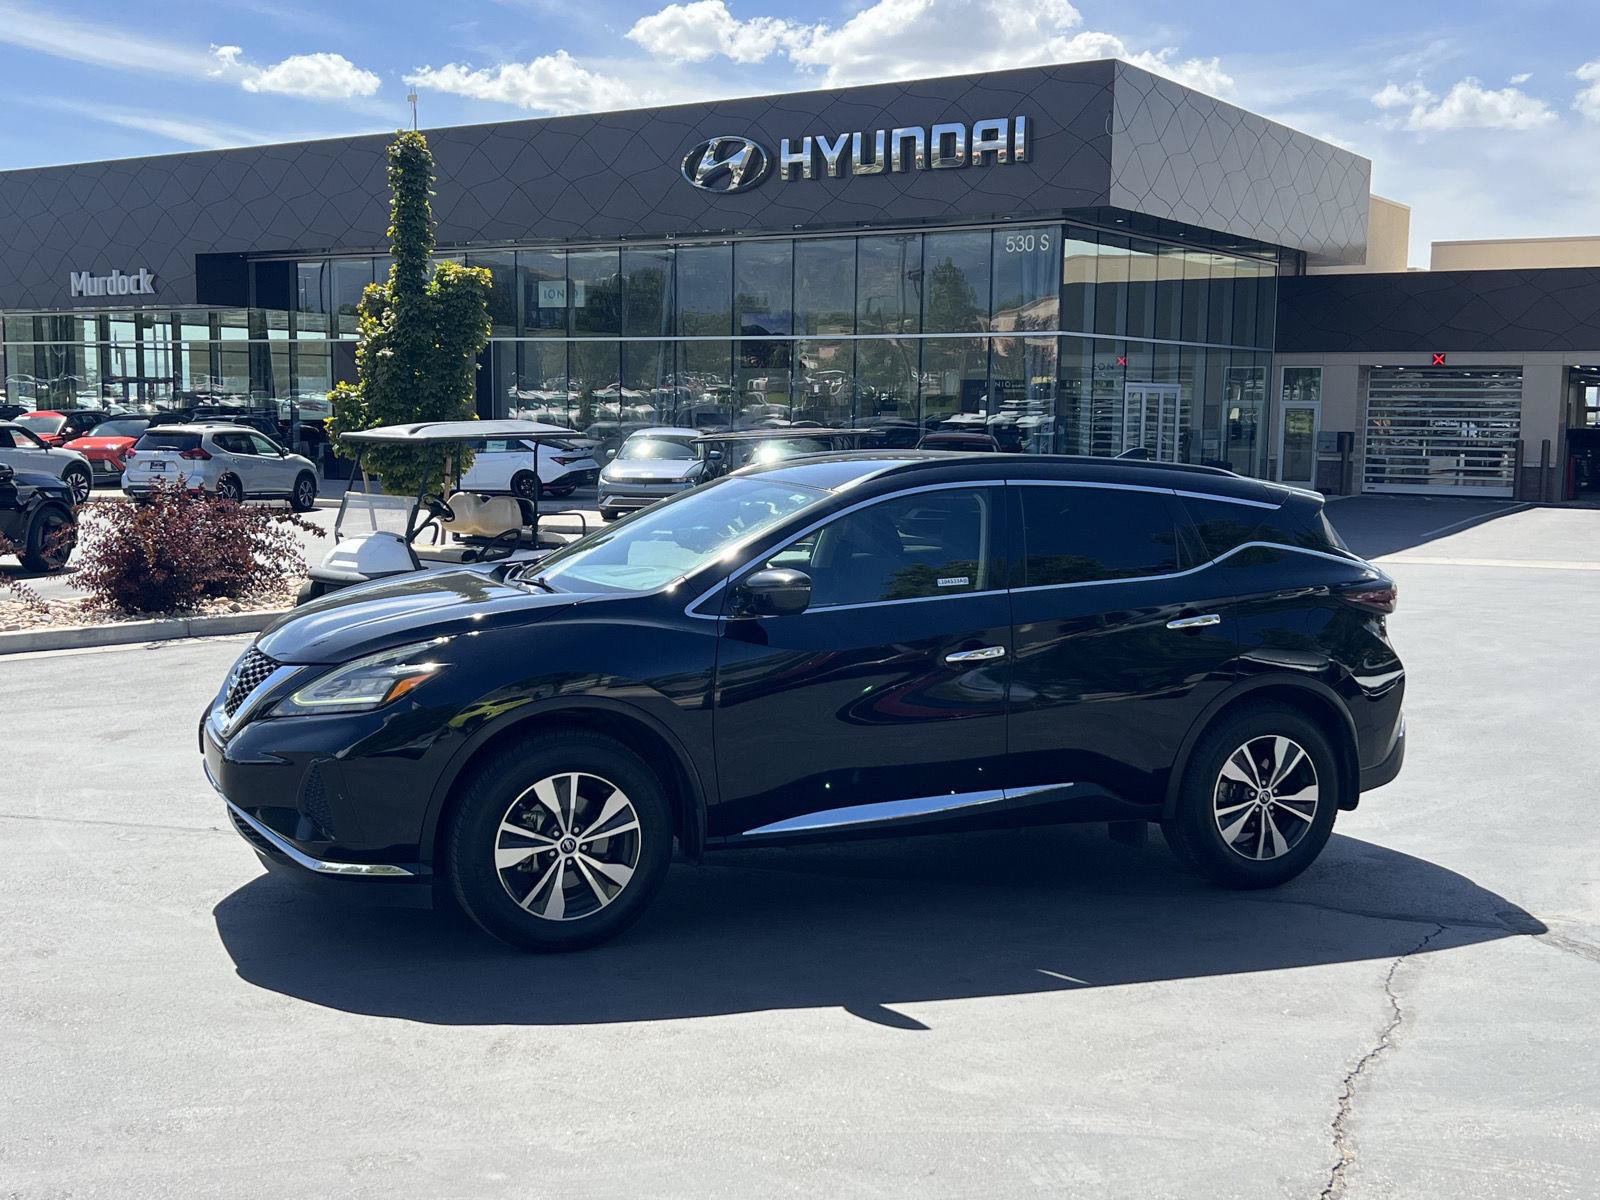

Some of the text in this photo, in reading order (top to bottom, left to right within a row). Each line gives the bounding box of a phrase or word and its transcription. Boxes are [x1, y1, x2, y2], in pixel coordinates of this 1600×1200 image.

[780, 115, 1026, 181] HYUNDAI
[1005, 233, 1050, 253] 530 S
[70, 267, 156, 297] Murdock
